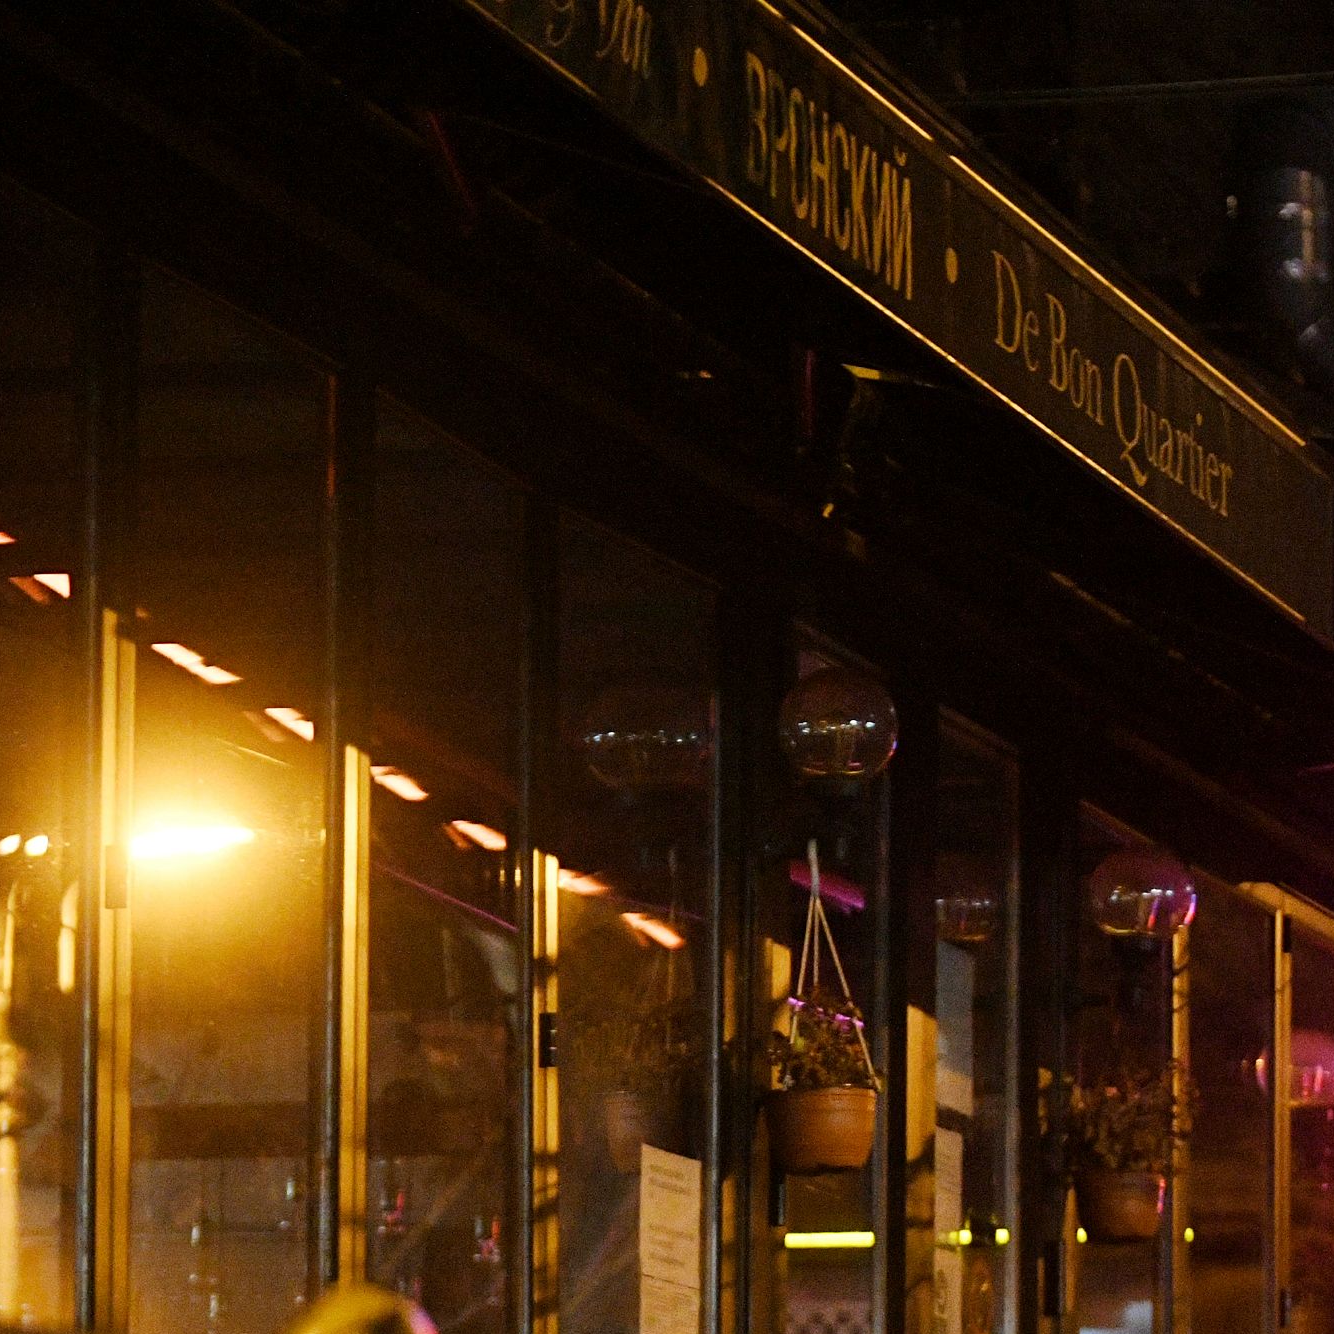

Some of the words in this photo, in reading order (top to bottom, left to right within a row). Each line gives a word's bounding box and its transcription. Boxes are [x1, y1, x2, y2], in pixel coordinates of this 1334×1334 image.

[746, 51, 913, 301] ВРОНСКИЙ
[991, 250, 1040, 372] De
[1045, 293, 1105, 427] Bon
[1113, 353, 1234, 519] Quartier
